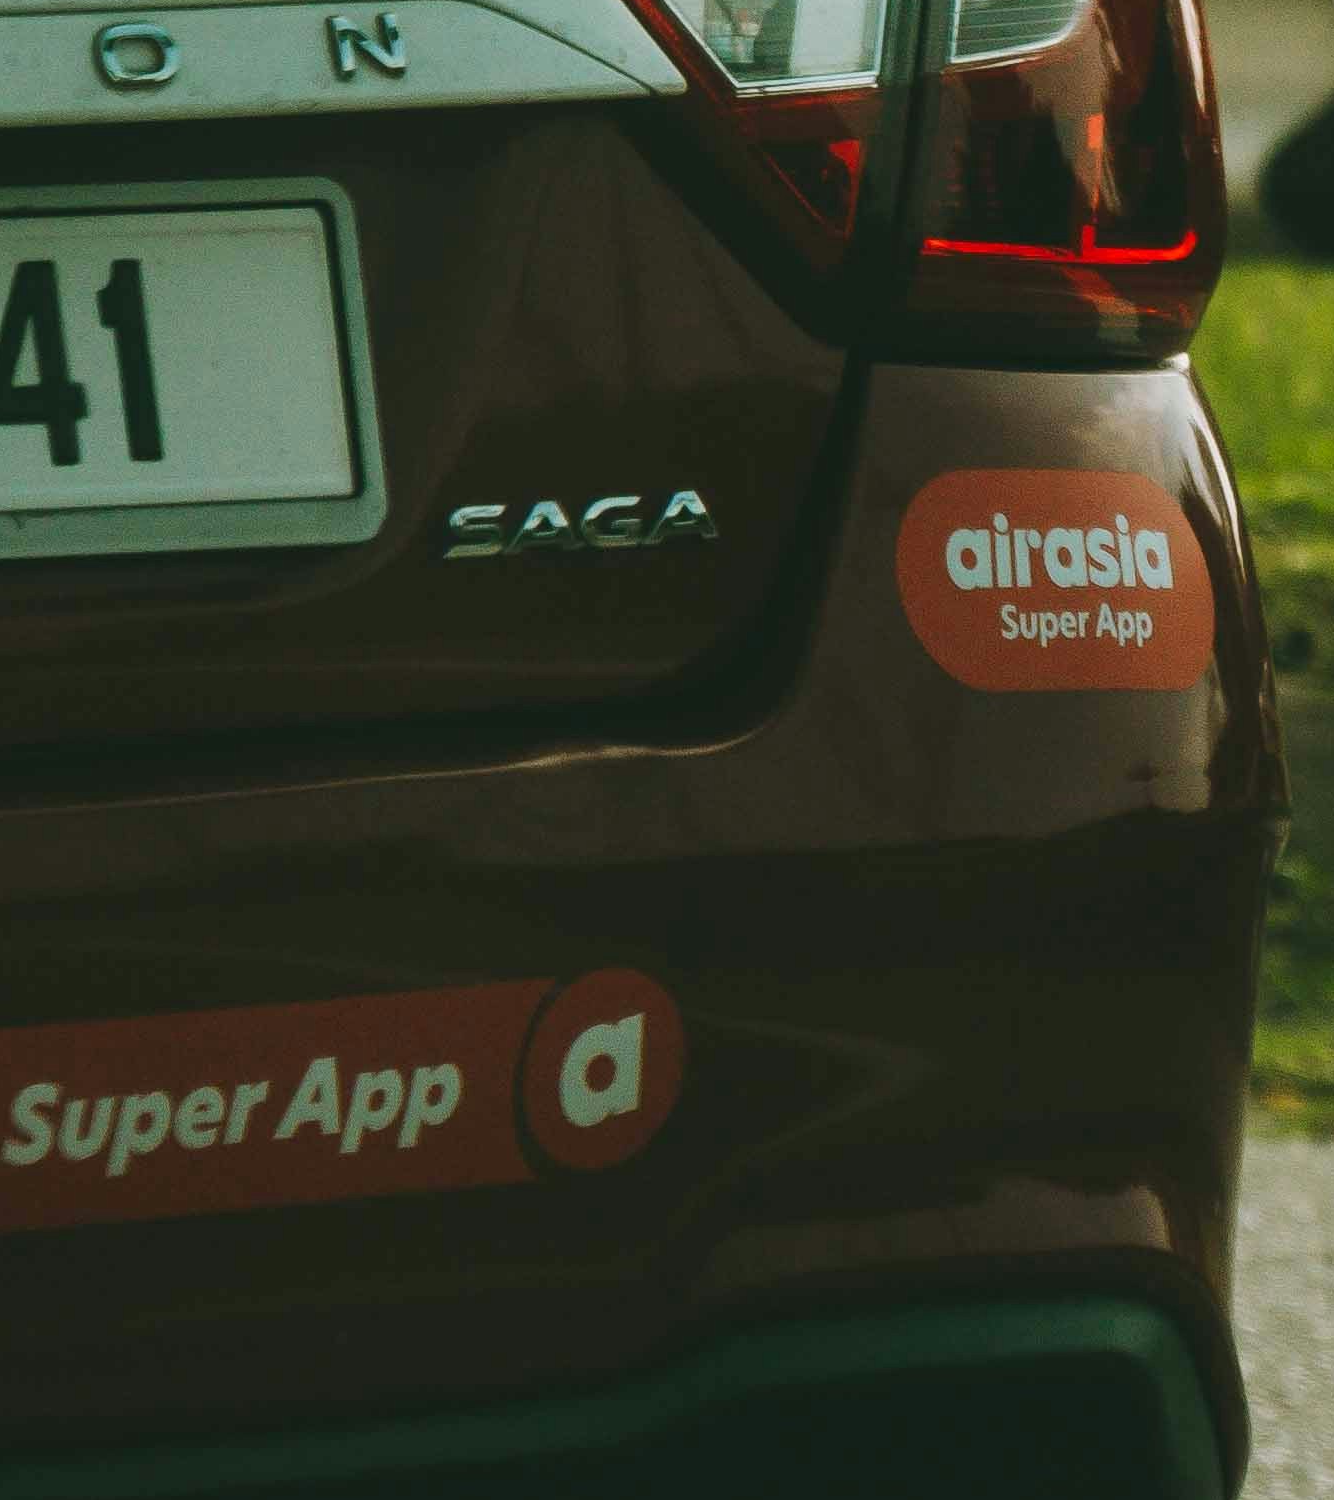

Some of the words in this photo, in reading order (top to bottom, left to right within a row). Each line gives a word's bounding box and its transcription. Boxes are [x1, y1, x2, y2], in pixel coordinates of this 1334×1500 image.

[443, 489, 720, 560] SAGA
[945, 512, 1174, 590] airasia
[1000, 603, 1091, 649] Super
[1095, 602, 1154, 649] App
[559, 1011, 647, 1128] a
[0, 1080, 270, 1178] Super
[272, 1055, 465, 1154] App
